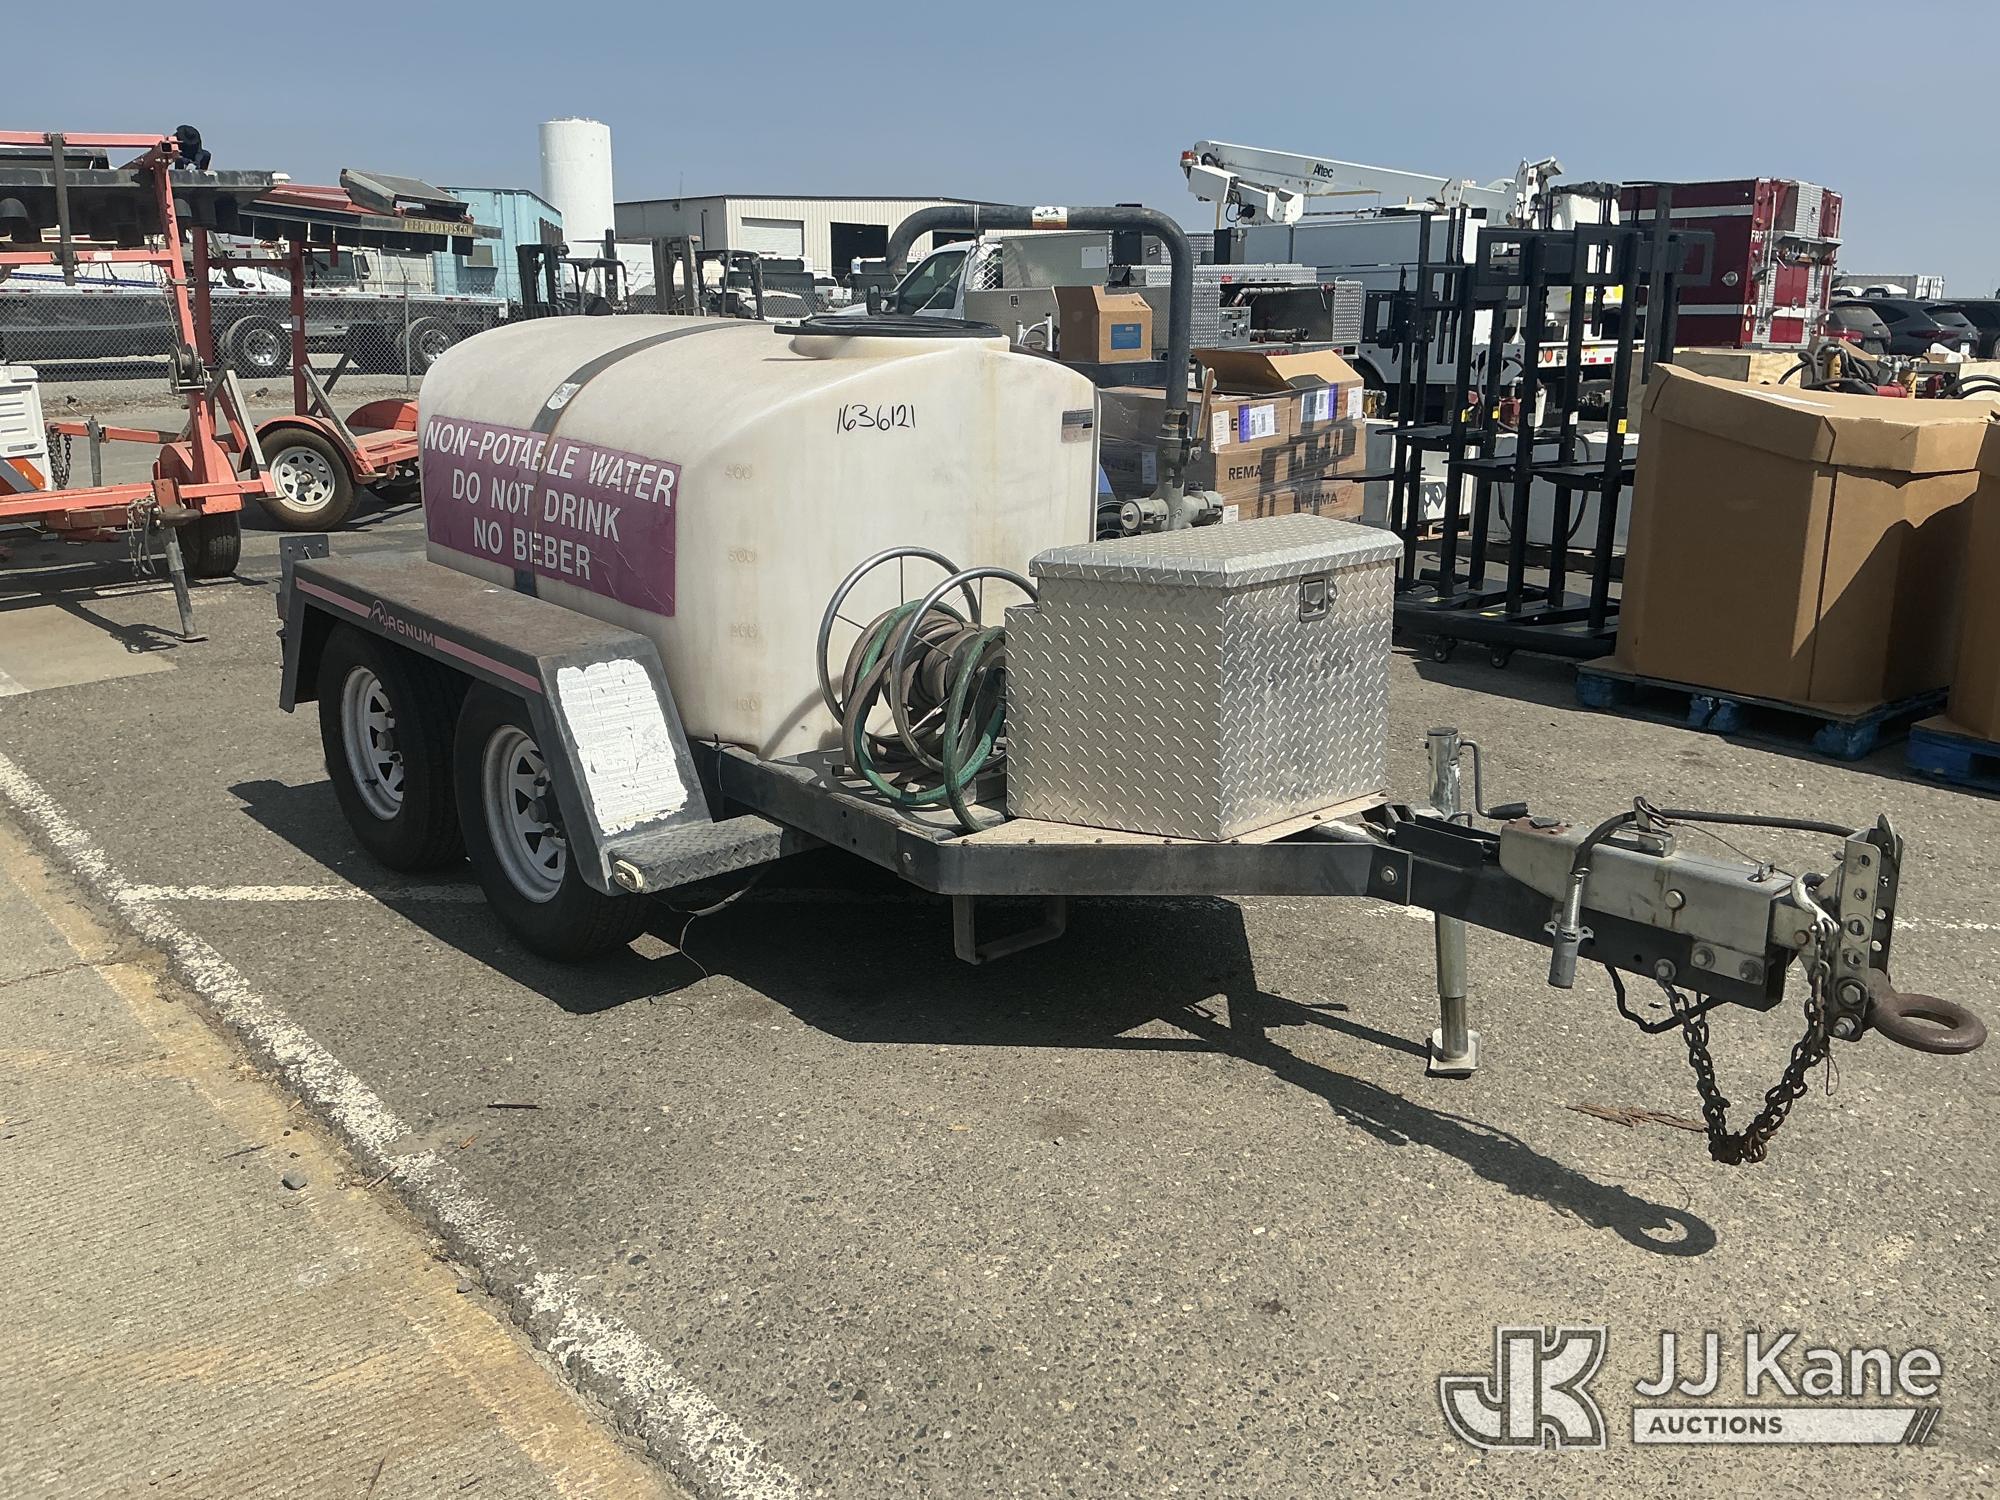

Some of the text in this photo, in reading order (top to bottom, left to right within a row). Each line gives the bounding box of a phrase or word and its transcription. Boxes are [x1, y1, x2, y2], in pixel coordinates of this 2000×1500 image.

[1313, 163, 1334, 178] Altec
[837, 404, 916, 434] 1636121
[424, 420, 676, 507] NON-POTABLE WATER
[452, 468, 621, 543] DO NOT DRINK
[473, 517, 591, 581] NO BEBER
